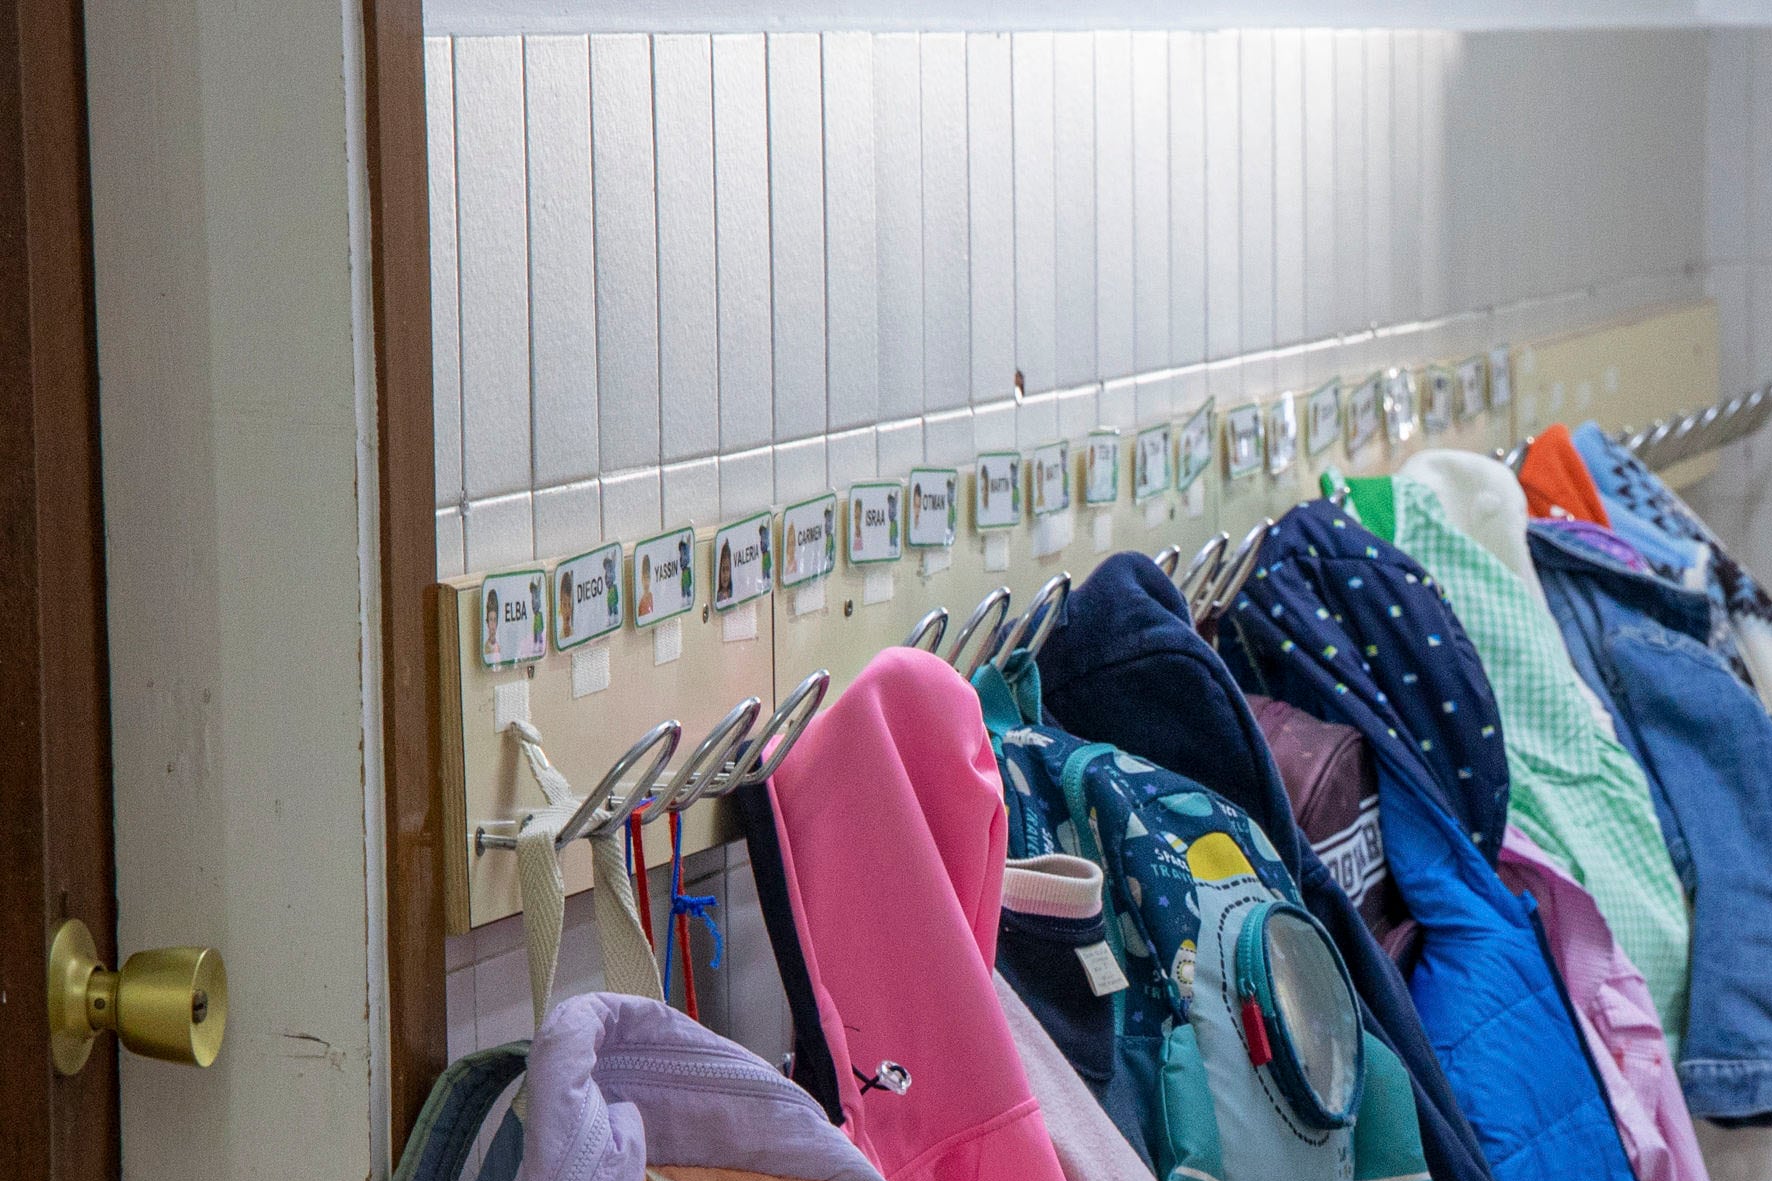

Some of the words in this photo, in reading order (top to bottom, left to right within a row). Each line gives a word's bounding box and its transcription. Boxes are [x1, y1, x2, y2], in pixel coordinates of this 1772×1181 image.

[797, 524, 823, 547] CARMEN
[733, 543, 760, 568] VALERIA
[654, 560, 679, 583] YASSIN
[577, 576, 604, 604] DIEGO
[504, 601, 528, 623] ELBA
